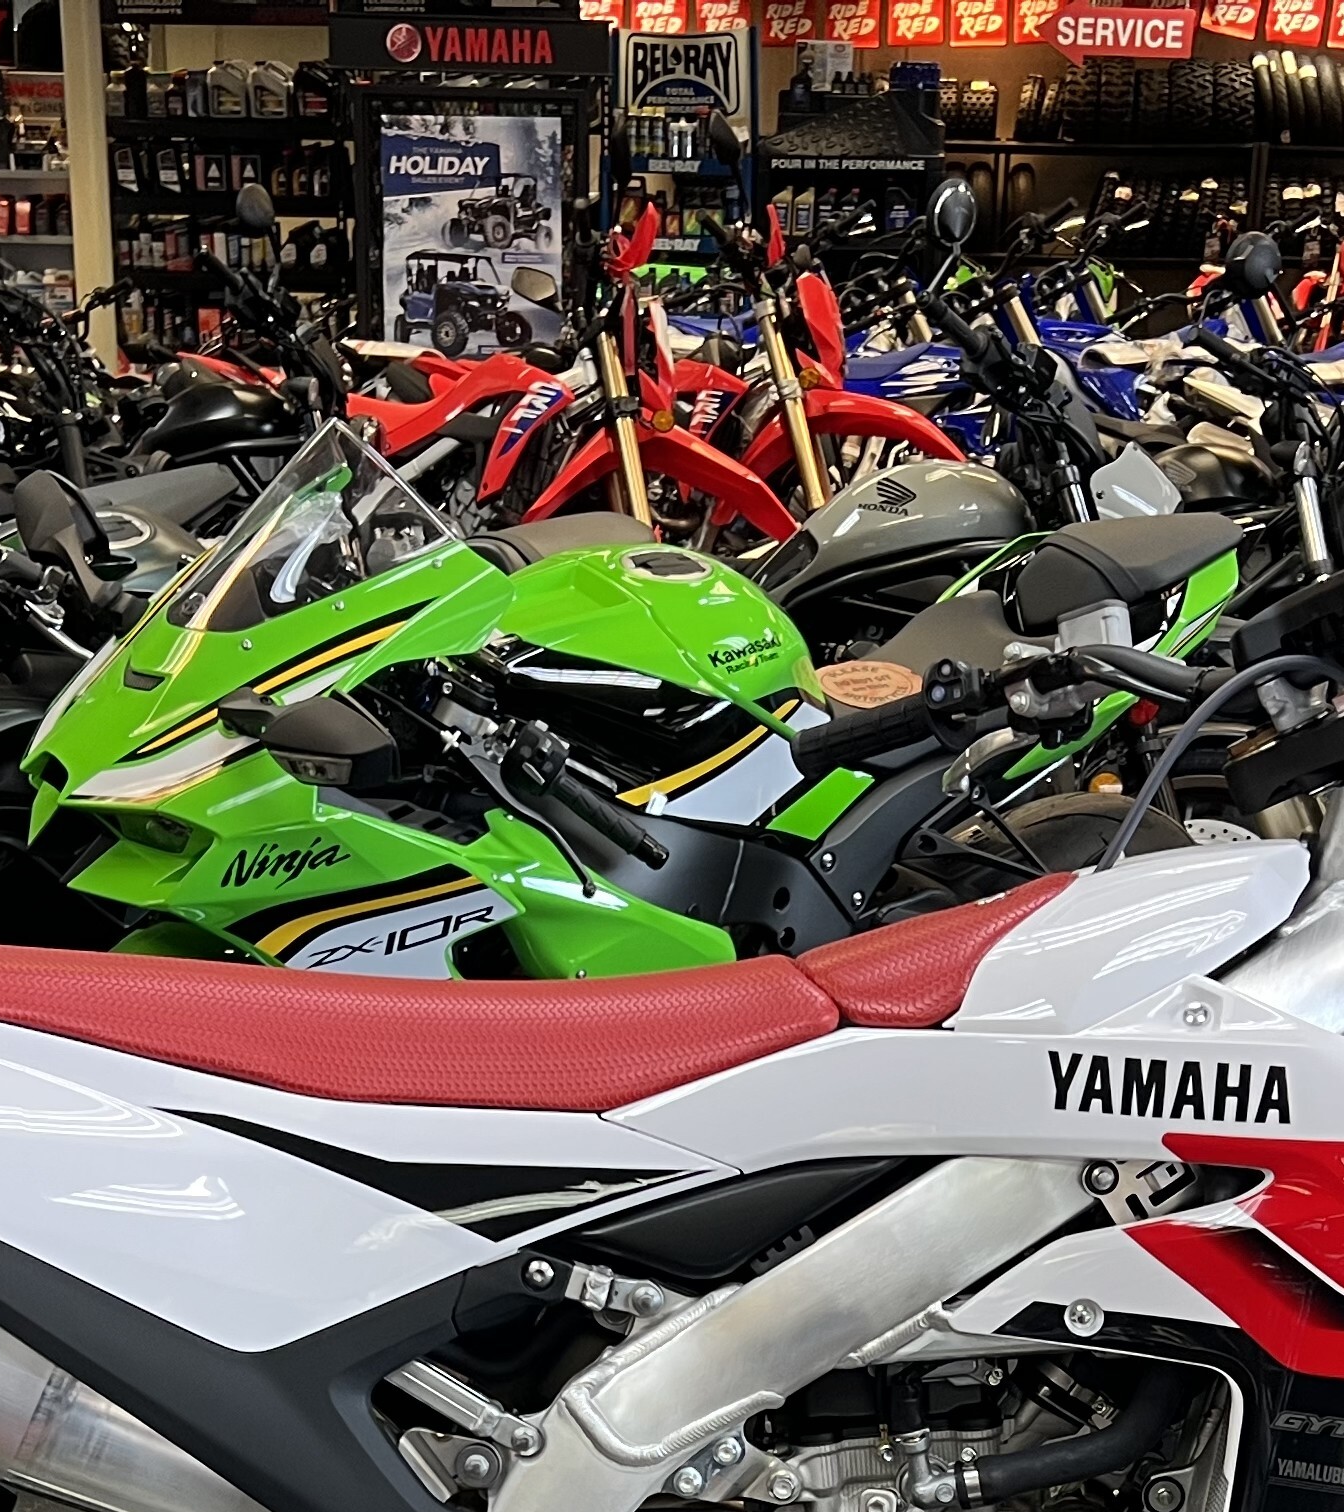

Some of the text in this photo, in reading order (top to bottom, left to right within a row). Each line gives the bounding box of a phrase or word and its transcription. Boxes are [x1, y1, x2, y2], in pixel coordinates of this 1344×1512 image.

[636, 0, 675, 17] RIDE
[700, 0, 739, 18] RIDE
[766, 0, 805, 19] RIDE
[829, 0, 869, 19] RIDE
[893, 0, 933, 18] RIDE
[956, 0, 996, 17] RIDE
[1212, 4, 1255, 26] RED
[1273, 0, 1315, 13] RIDE
[640, 17, 682, 33] RED
[769, 17, 812, 40] RED
[832, 17, 876, 40] RED
[896, 16, 940, 39] RED
[959, 14, 1003, 38] RED
[1057, 17, 1184, 48] SERVICE
[1274, 13, 1319, 35] RED
[425, 26, 553, 64] YAMAHA
[389, 156, 490, 175] HOLIDAY
[771, 159, 925, 170] POUR IN THE PERFORMANCE
[858, 503, 908, 516] HONDA
[707, 631, 781, 668] Kawasaki
[220, 836, 351, 889] Ninja
[1048, 1051, 1292, 1125] YAMAHA
